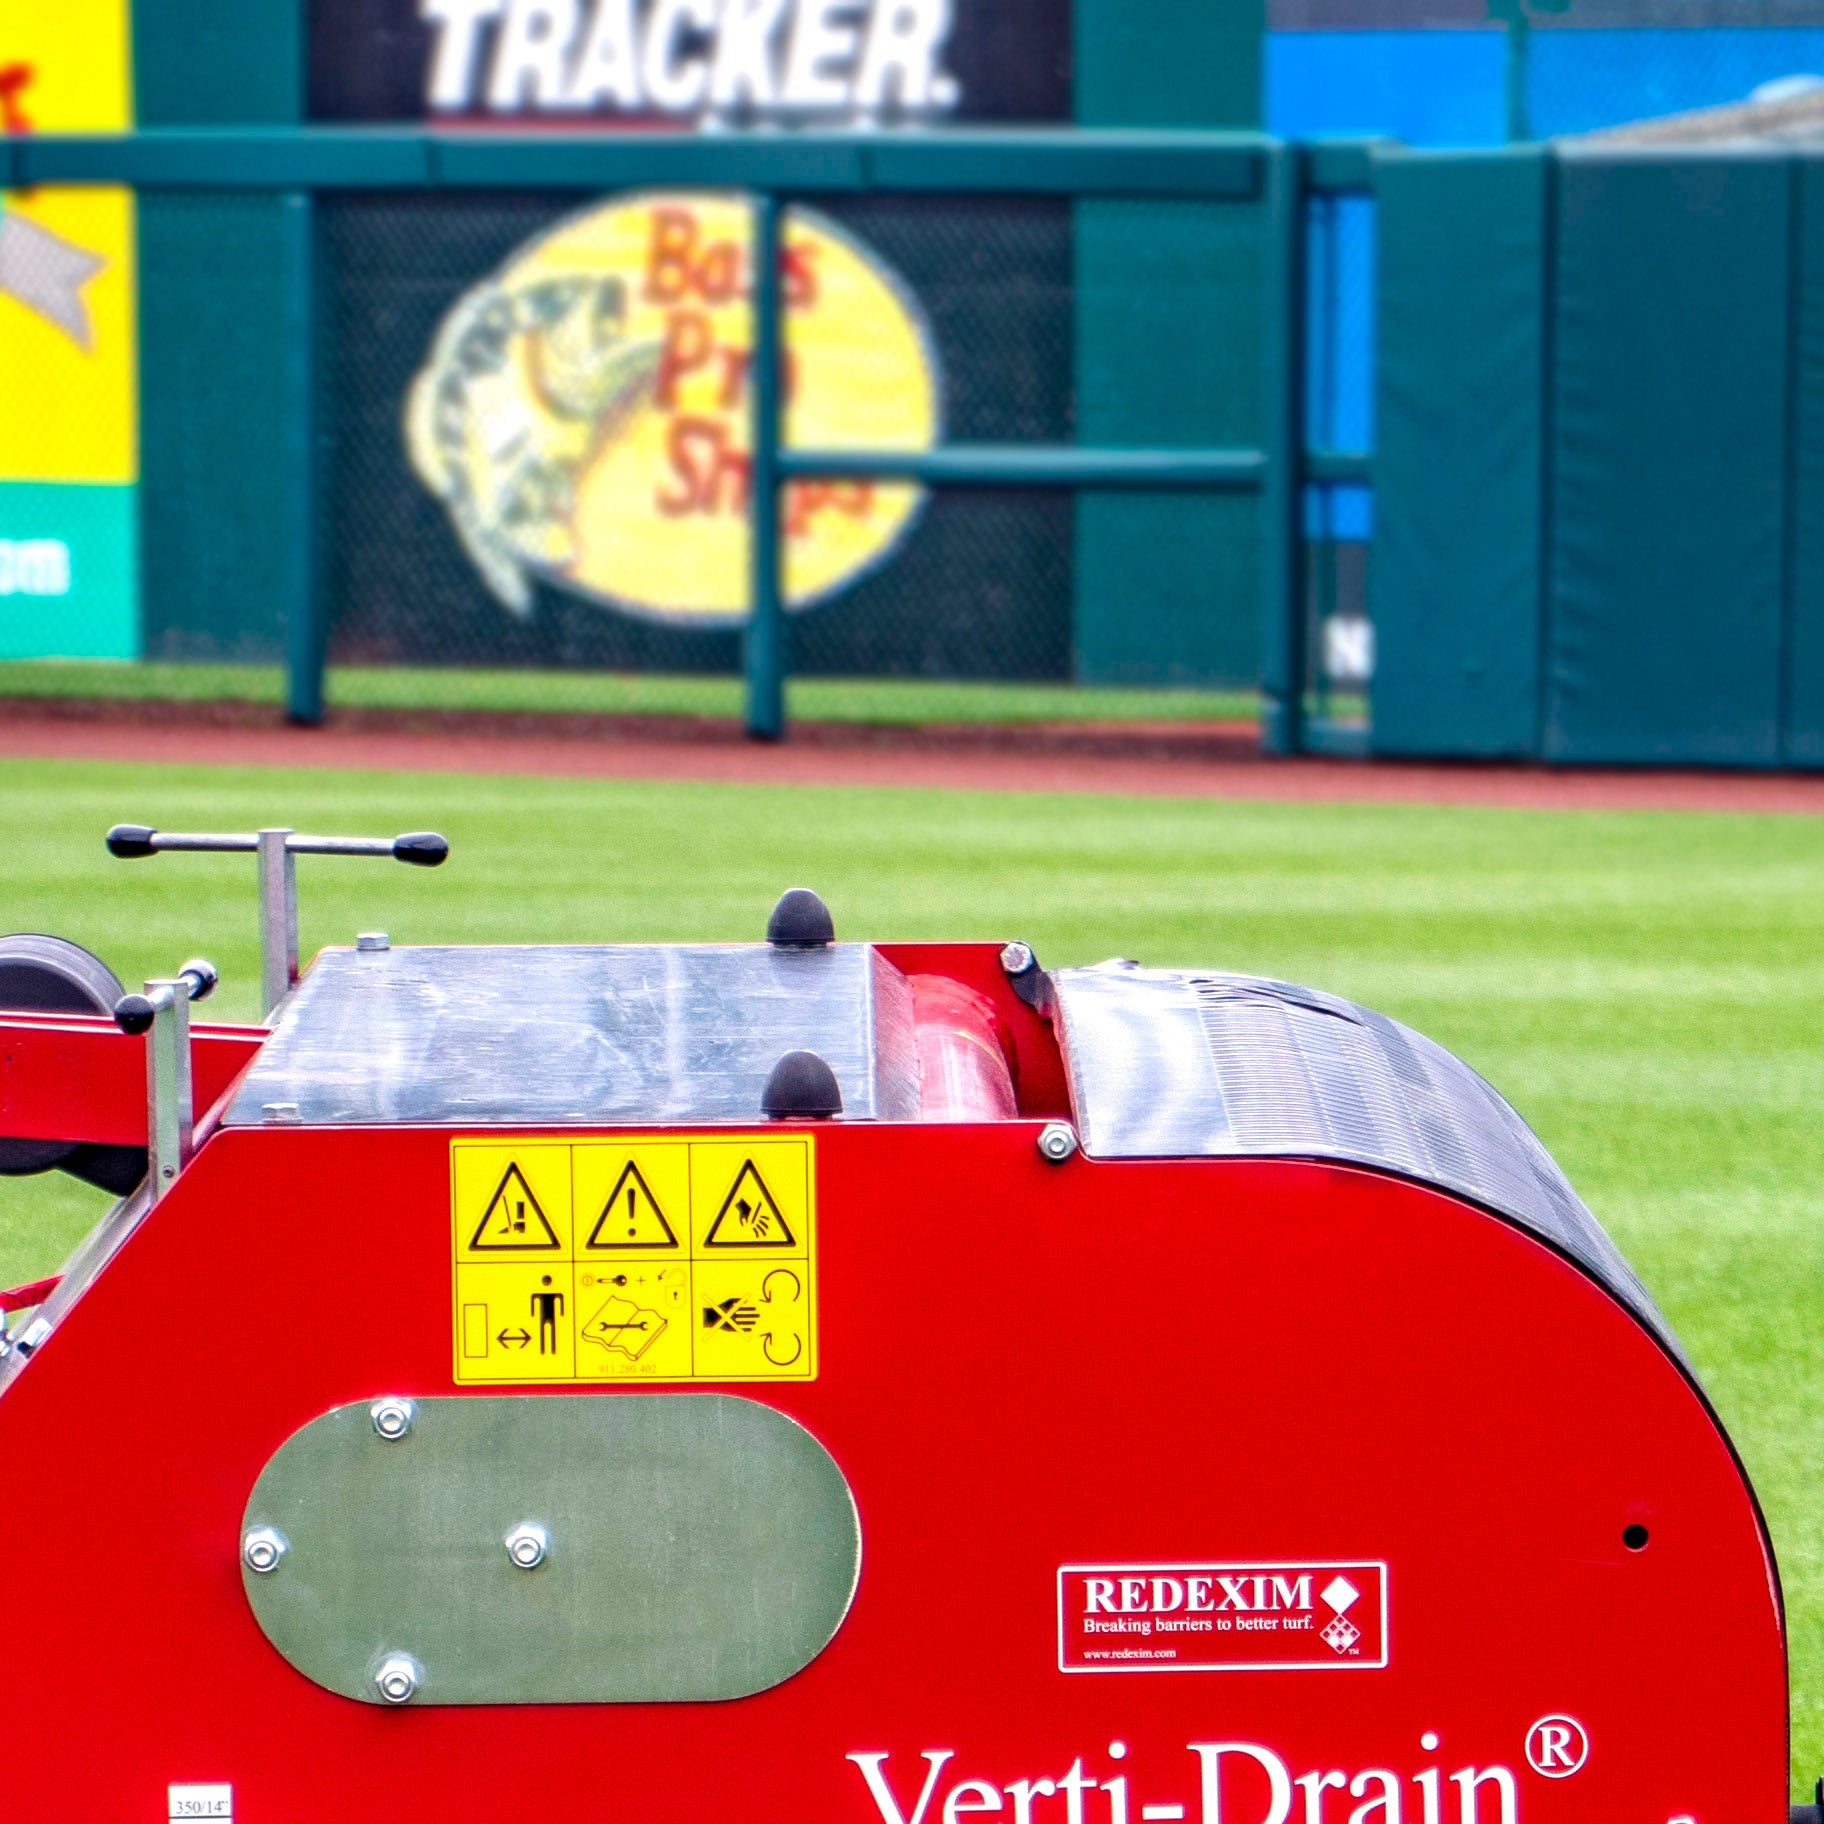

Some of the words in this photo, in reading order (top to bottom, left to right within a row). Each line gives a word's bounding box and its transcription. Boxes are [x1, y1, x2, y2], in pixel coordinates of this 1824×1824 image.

[644, 206, 822, 312] Bas
[654, 309, 800, 410] Pr
[1082, 1574, 1314, 1614] REDEXIM
[1083, 1617, 1152, 1636] Breaking
[1155, 1616, 1213, 1632] barriers
[1217, 1616, 1231, 1631] to
[1235, 1615, 1278, 1631] better
[1283, 1614, 1315, 1630] turf.
[1083, 1648, 1176, 1660] www.redexim.com
